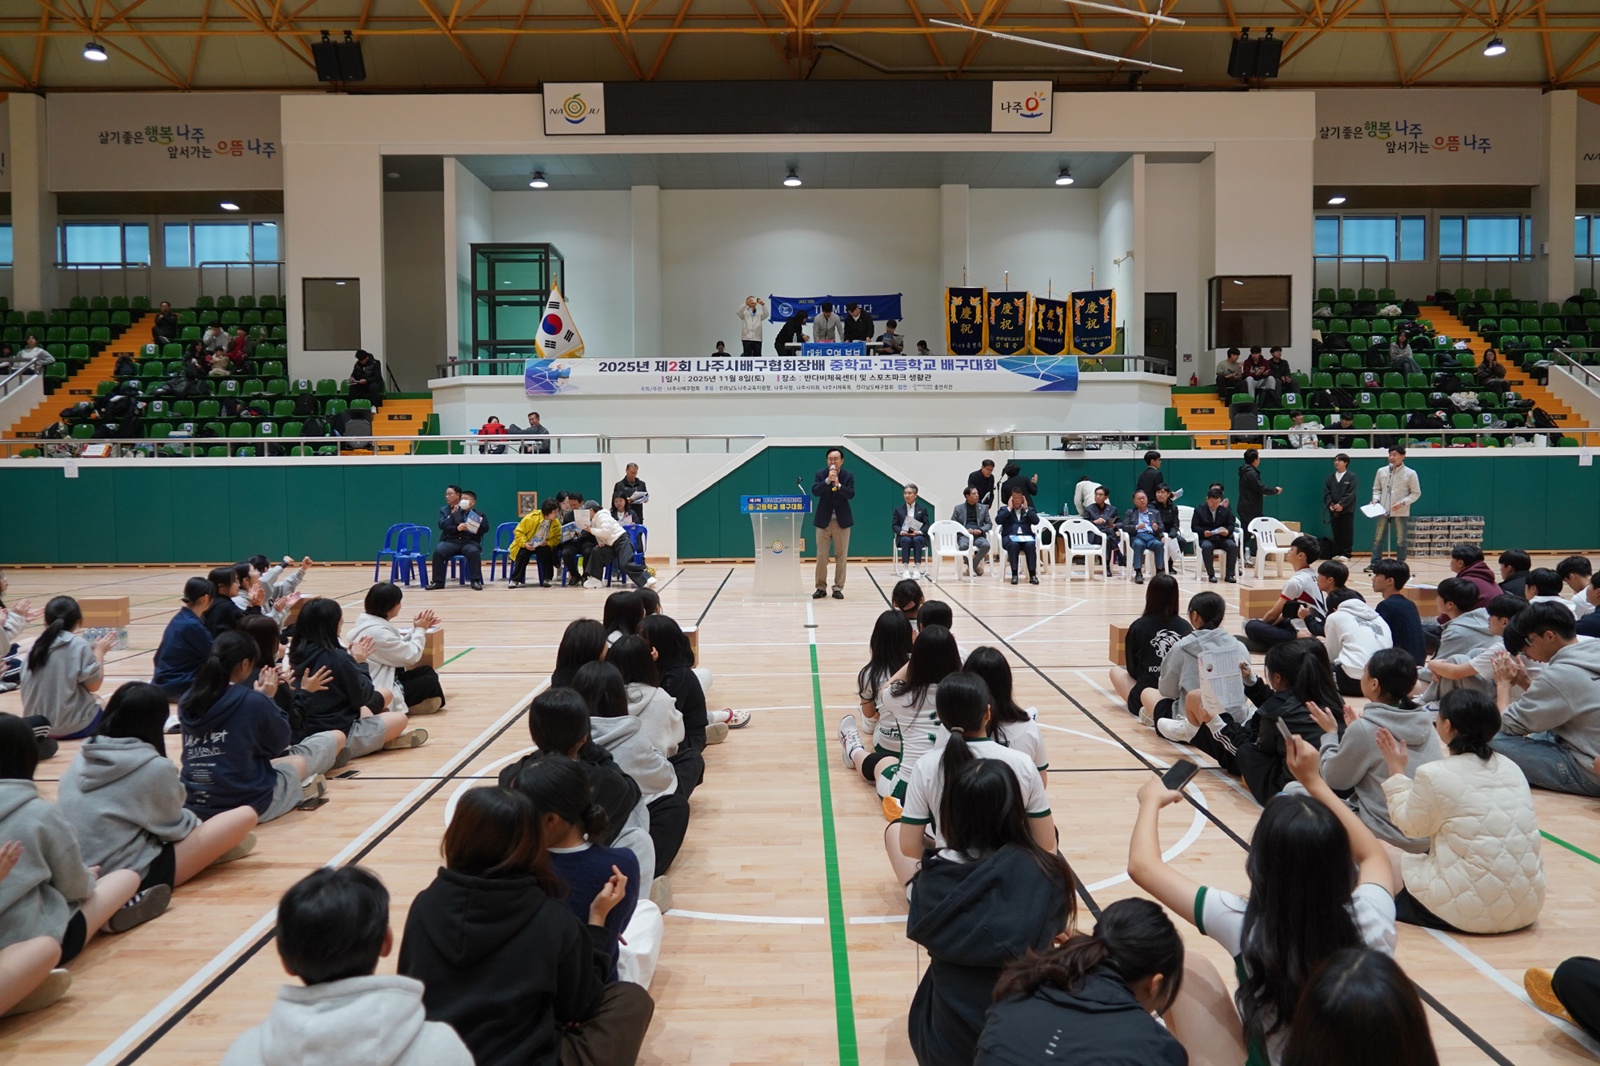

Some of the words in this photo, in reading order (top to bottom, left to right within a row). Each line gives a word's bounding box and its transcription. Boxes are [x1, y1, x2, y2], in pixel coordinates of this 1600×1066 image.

[1001, 101, 1023, 113] 나주
[144, 126, 174, 144] 행복
[176, 124, 206, 144] 나주
[1364, 121, 1392, 139] 행복
[1395, 120, 1423, 139] 나주
[167, 145, 213, 159] 앞서가는
[215, 140, 244, 157] 으뜸
[247, 138, 277, 159] 나주
[1386, 141, 1430, 154] 앞서가는
[1432, 136, 1460, 152] 으뜸
[1464, 134, 1492, 154] 나주
[599, 361, 649, 372] 2025년
[654, 360, 691, 372] 제2회
[697, 359, 825, 372] 나주시배구협회장배
[940, 358, 997, 371] 배구대회
[665, 375, 681, 383] 일시
[688, 375, 716, 383] 2025년
